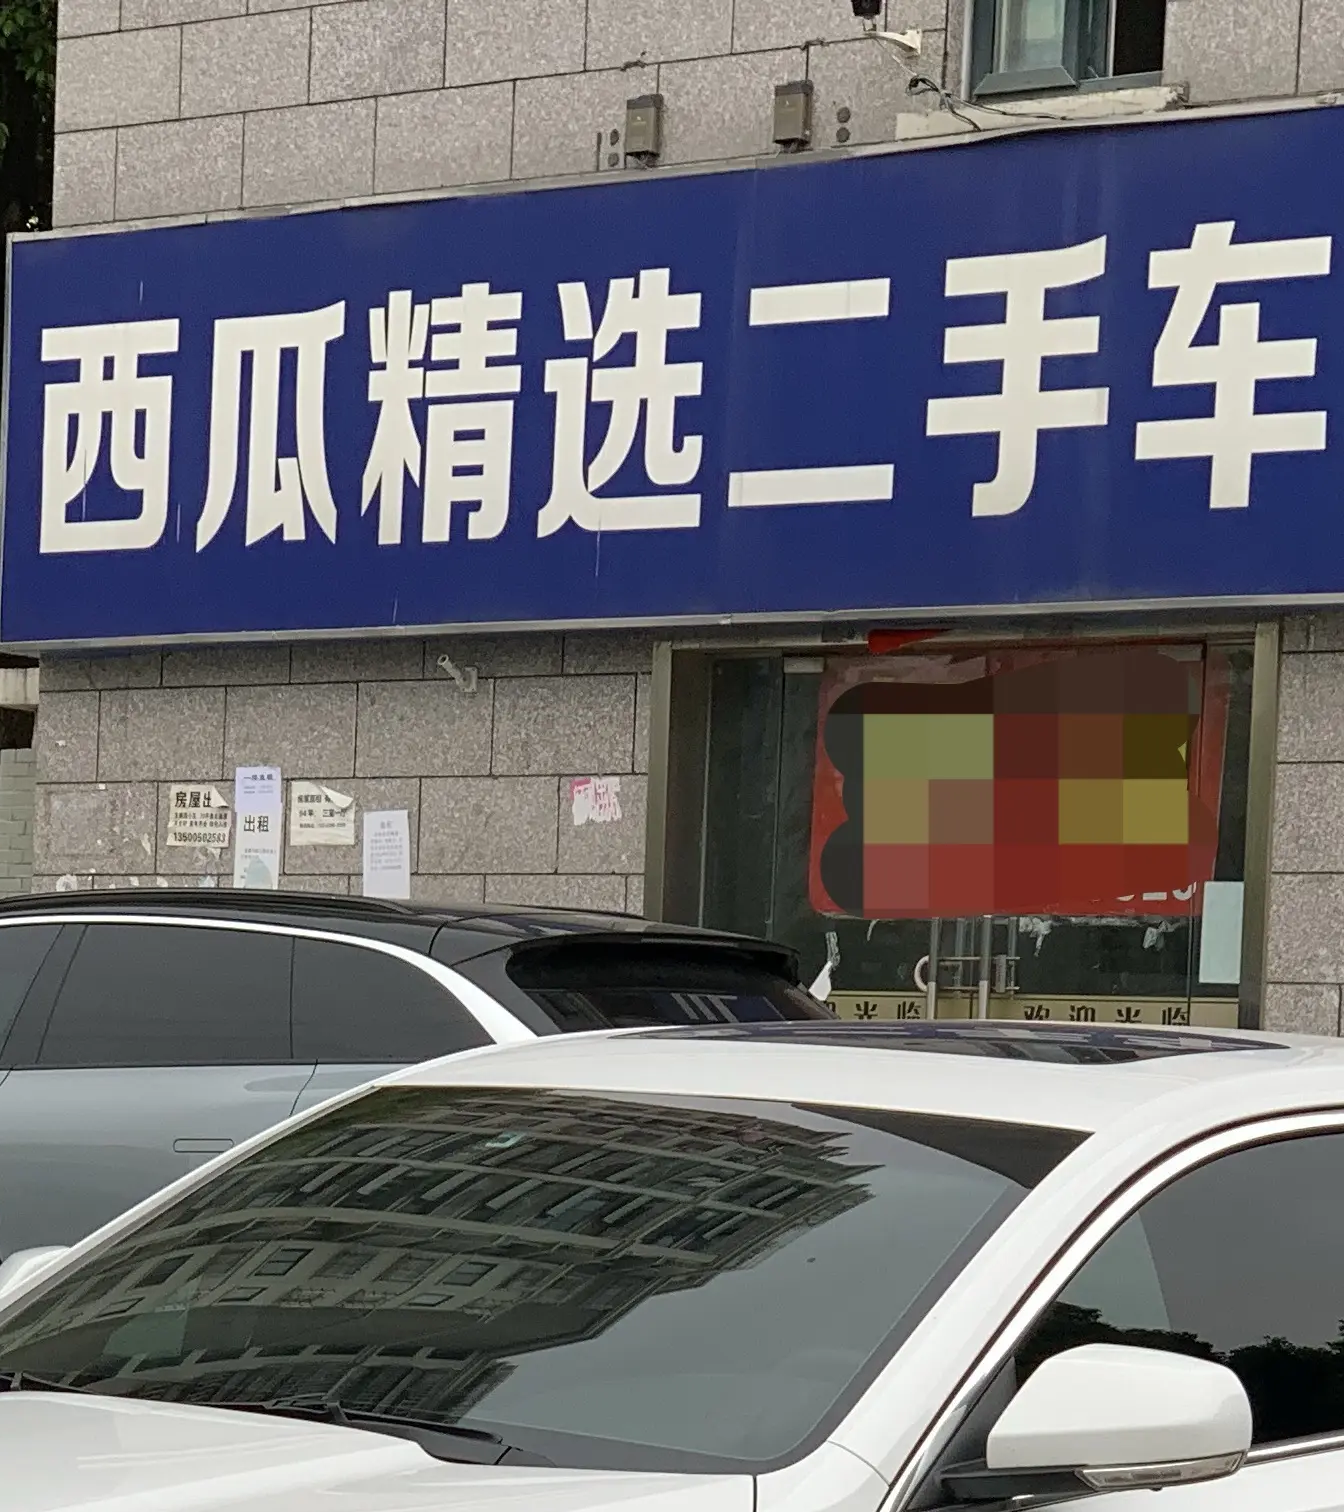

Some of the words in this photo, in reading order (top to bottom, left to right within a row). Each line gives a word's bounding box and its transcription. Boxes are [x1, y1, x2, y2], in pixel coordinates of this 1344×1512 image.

[39, 221, 1333, 554] 西瓜精选二手车
[244, 815, 269, 833] 出租
